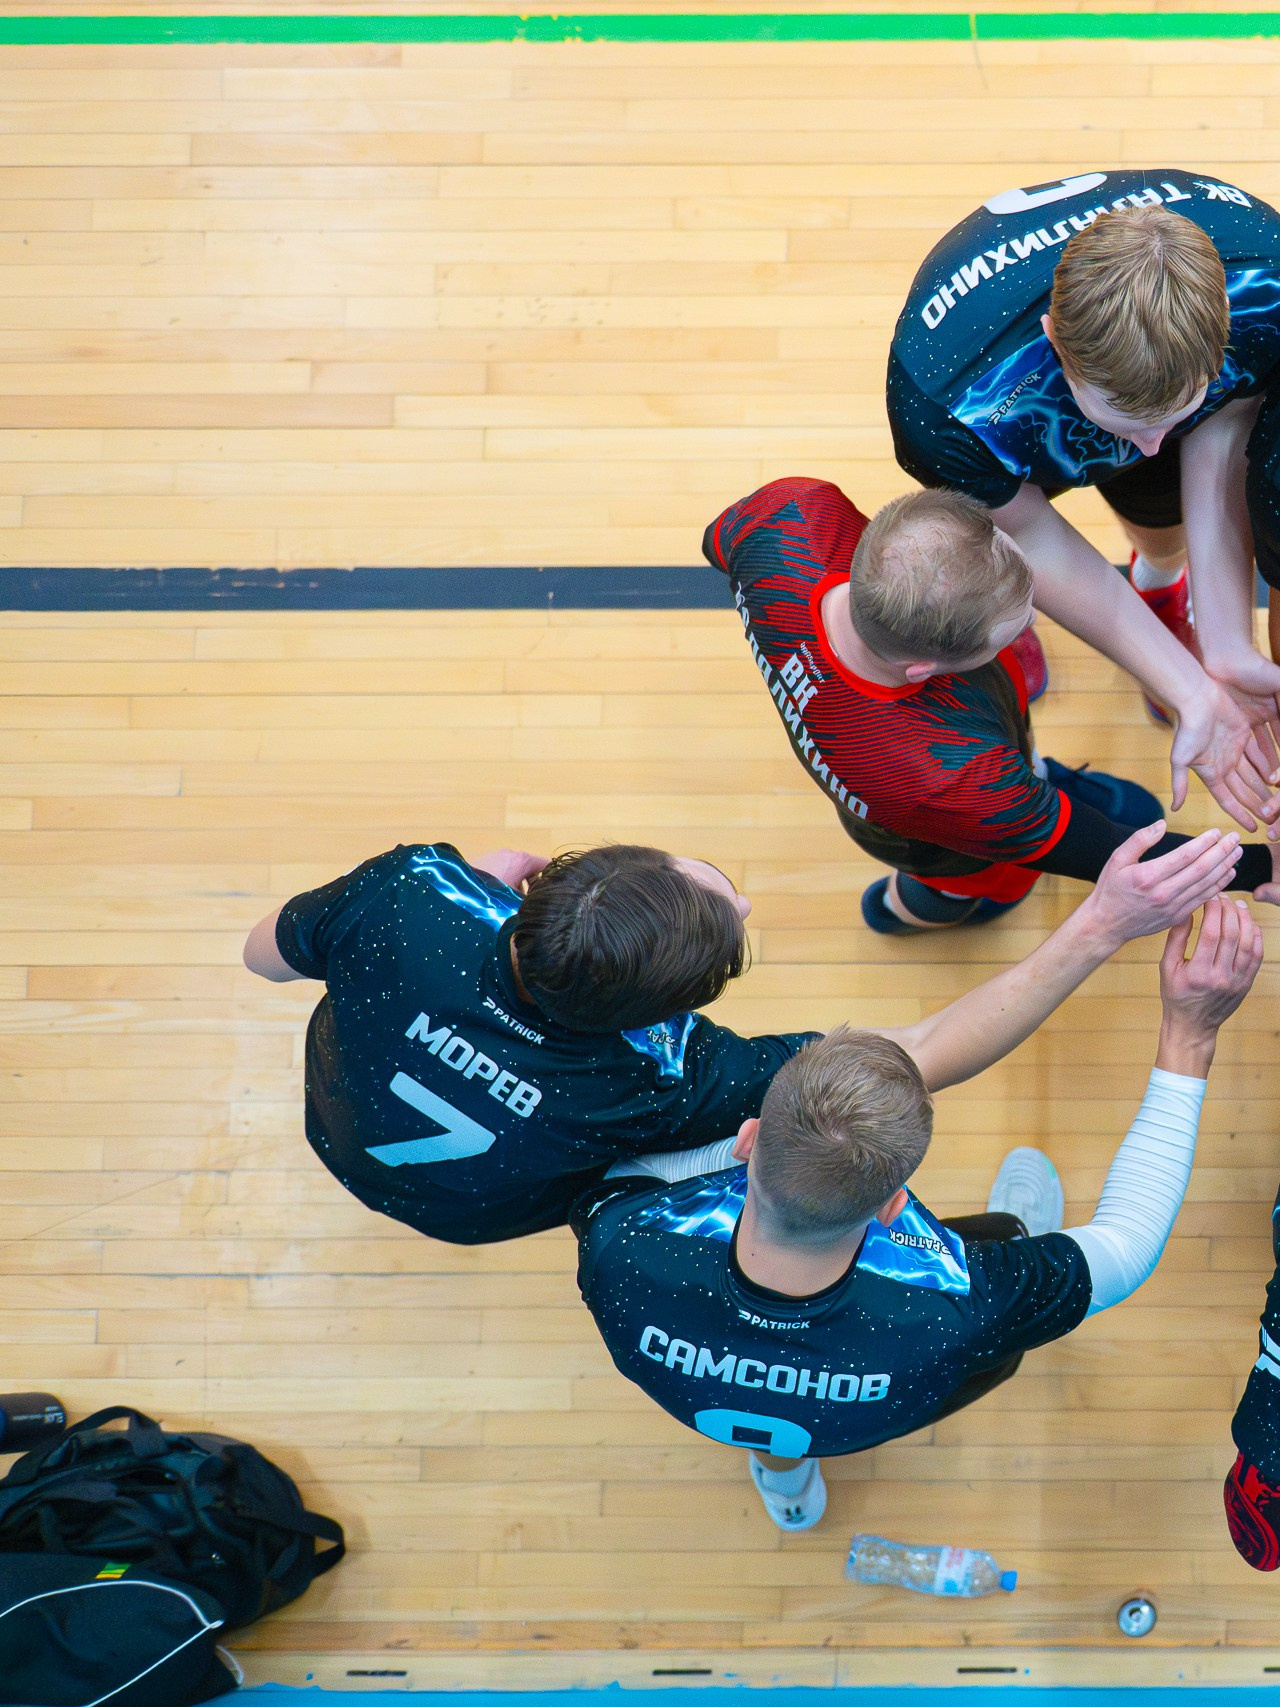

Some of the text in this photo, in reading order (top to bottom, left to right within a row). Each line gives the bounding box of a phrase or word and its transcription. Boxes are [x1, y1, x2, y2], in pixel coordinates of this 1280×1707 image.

[1193, 181, 1253, 208] ВК
[999, 373, 1042, 414] PATRICK
[780, 652, 818, 715] ВК
[494, 1007, 546, 1046] PATRICK
[405, 1011, 542, 1118] МОРЕВ
[365, 1071, 497, 1167] 7
[889, 1228, 941, 1253] PATRICK
[751, 1315, 810, 1330] PATRICK
[639, 1325, 892, 1402] САМСОНОВ
